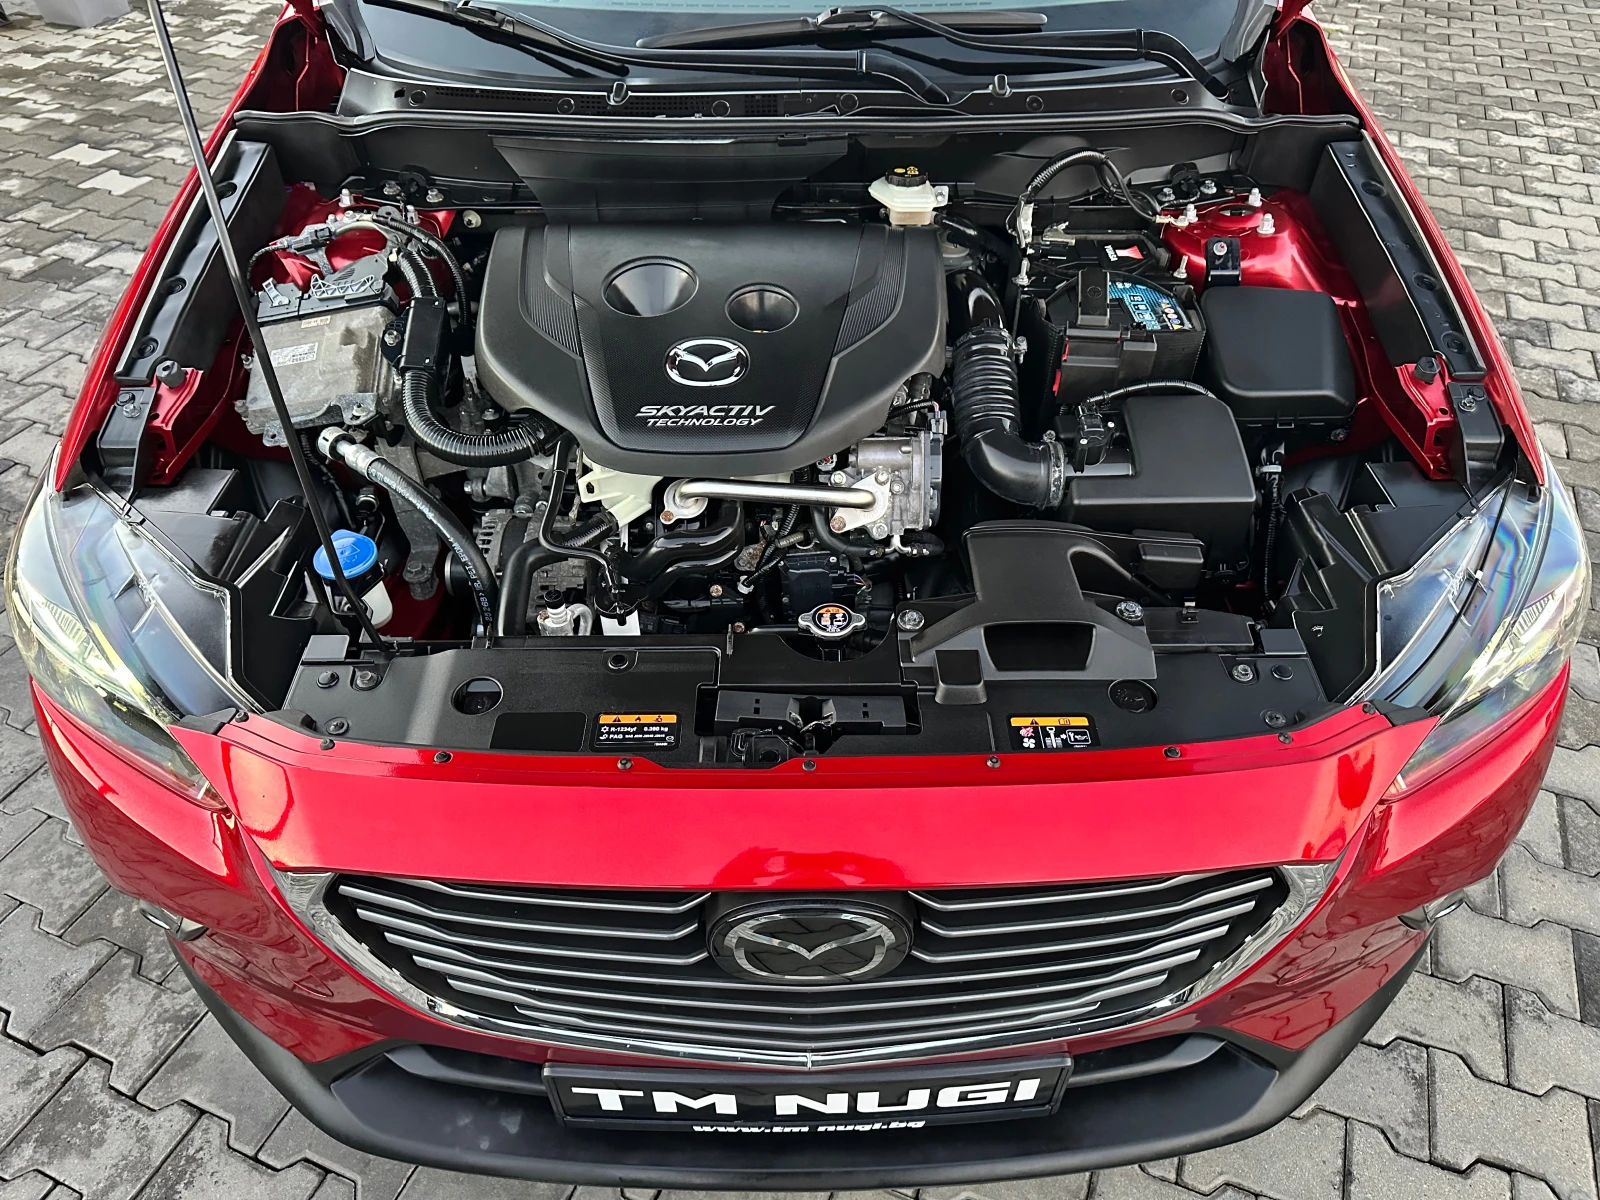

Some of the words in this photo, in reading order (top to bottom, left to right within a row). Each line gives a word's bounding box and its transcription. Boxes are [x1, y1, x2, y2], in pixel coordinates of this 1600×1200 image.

[635, 405, 777, 417] SKYACTIV
[646, 418, 763, 428] TECHNOLOGY
[571, 1086, 738, 1115] TM
[775, 1078, 1041, 1116] NUGI
